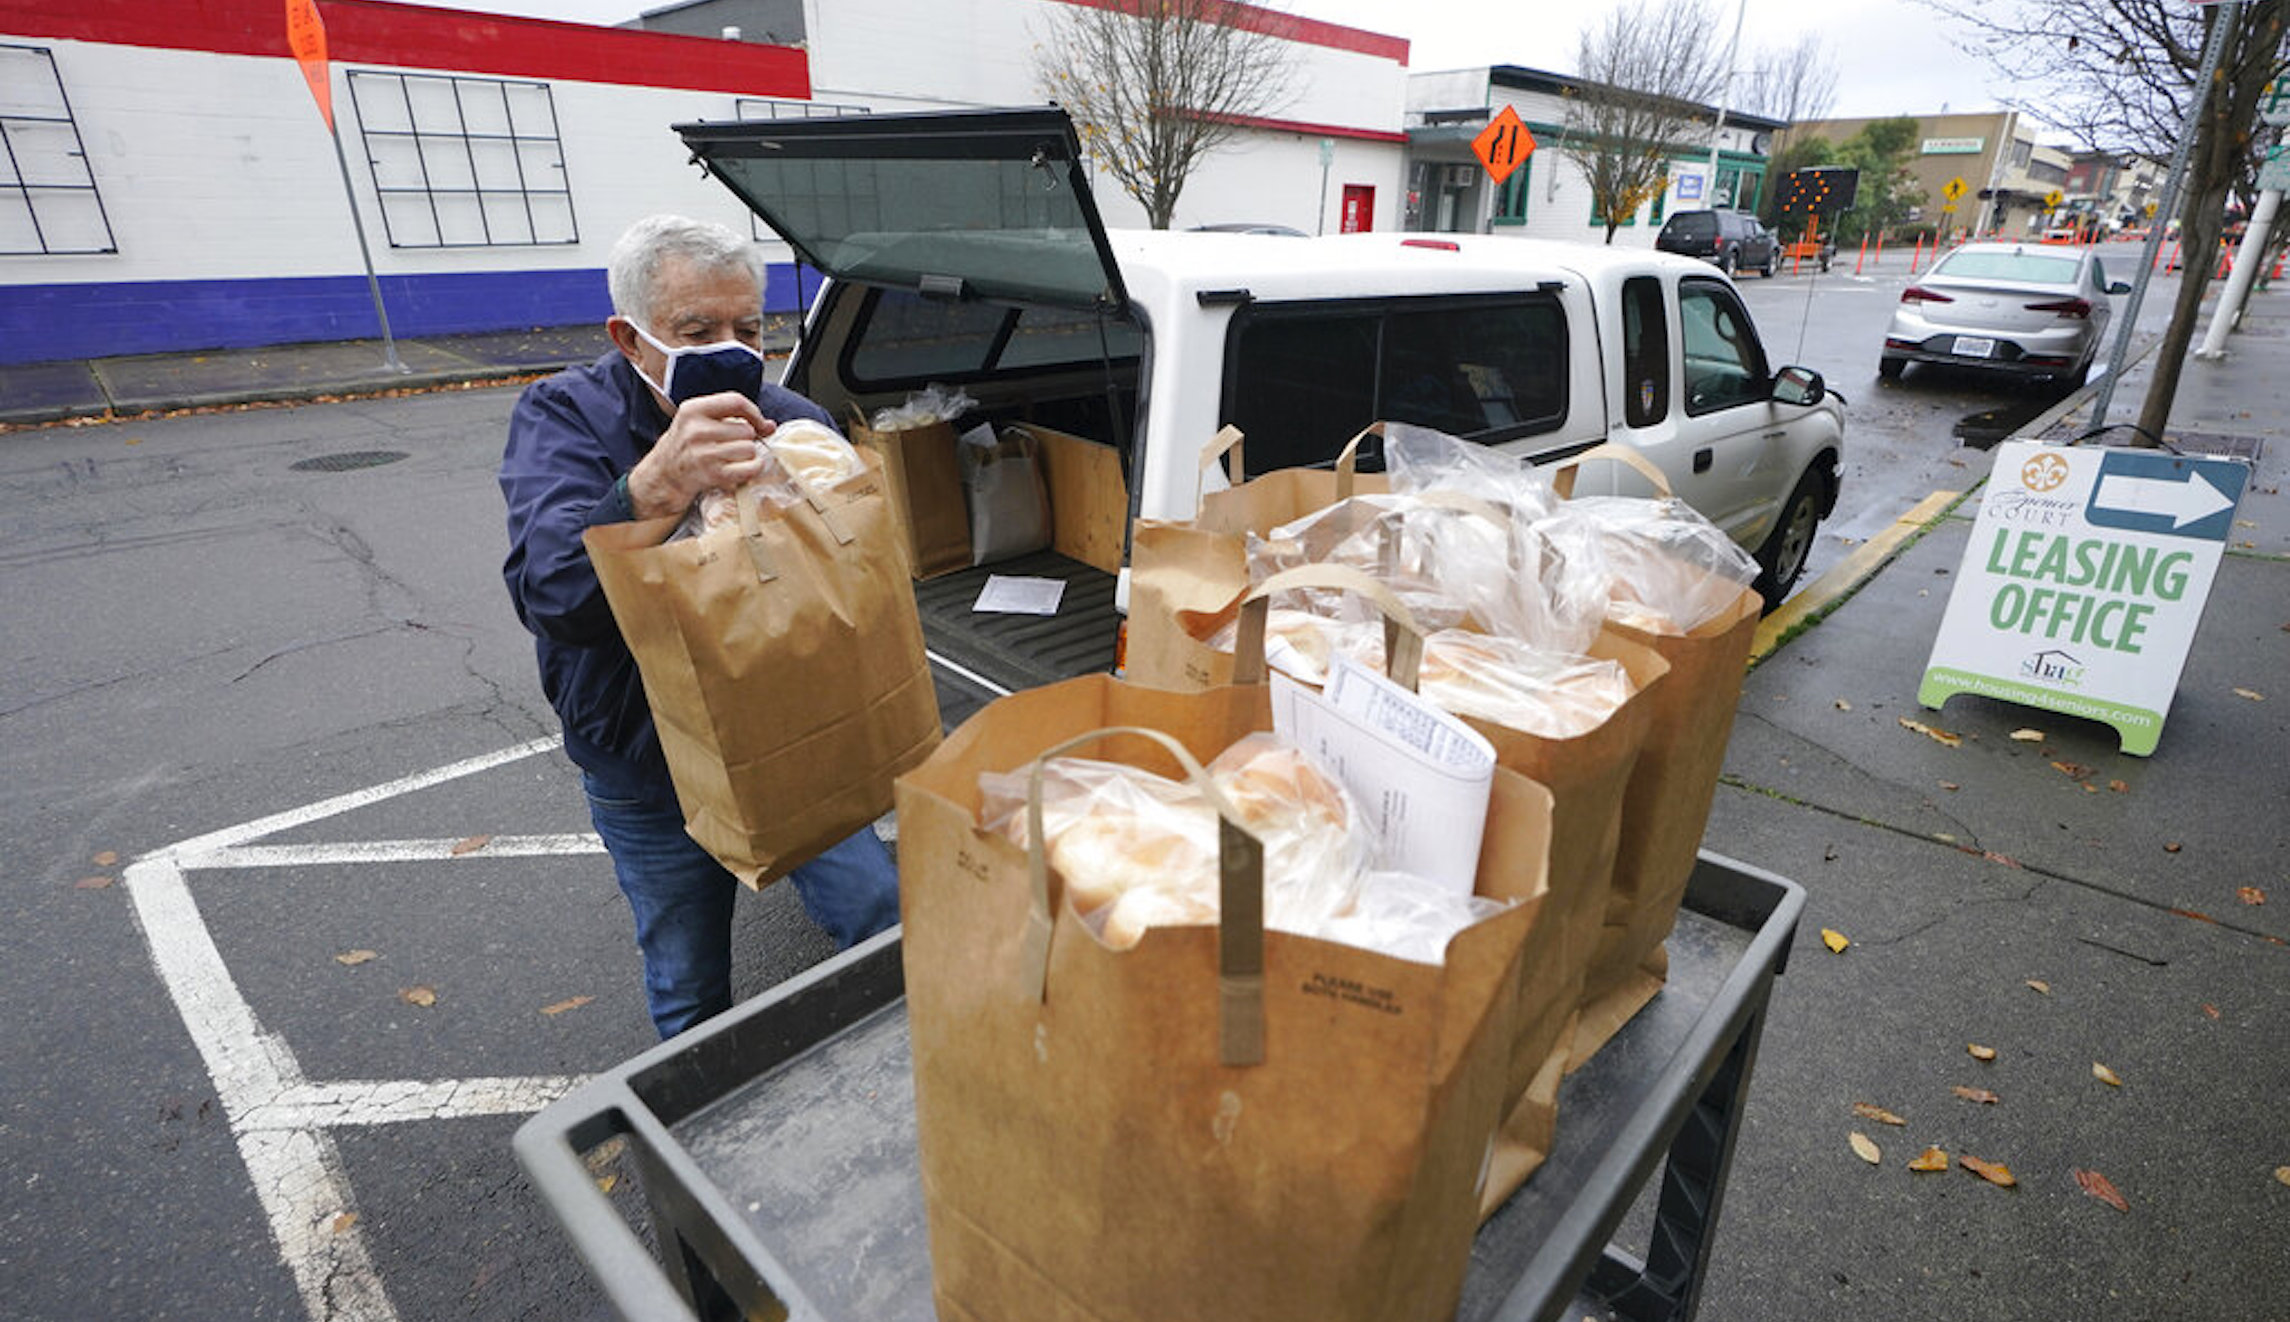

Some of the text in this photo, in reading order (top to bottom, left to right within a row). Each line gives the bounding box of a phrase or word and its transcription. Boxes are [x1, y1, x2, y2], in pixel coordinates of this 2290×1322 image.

[1988, 504, 2072, 526] COURT
[1993, 488, 2075, 510] Spencer
[1985, 528, 2195, 602] LEASING
[1990, 584, 2156, 655] OFFICE
[1932, 673, 2152, 728] www.housing4seniors.com
